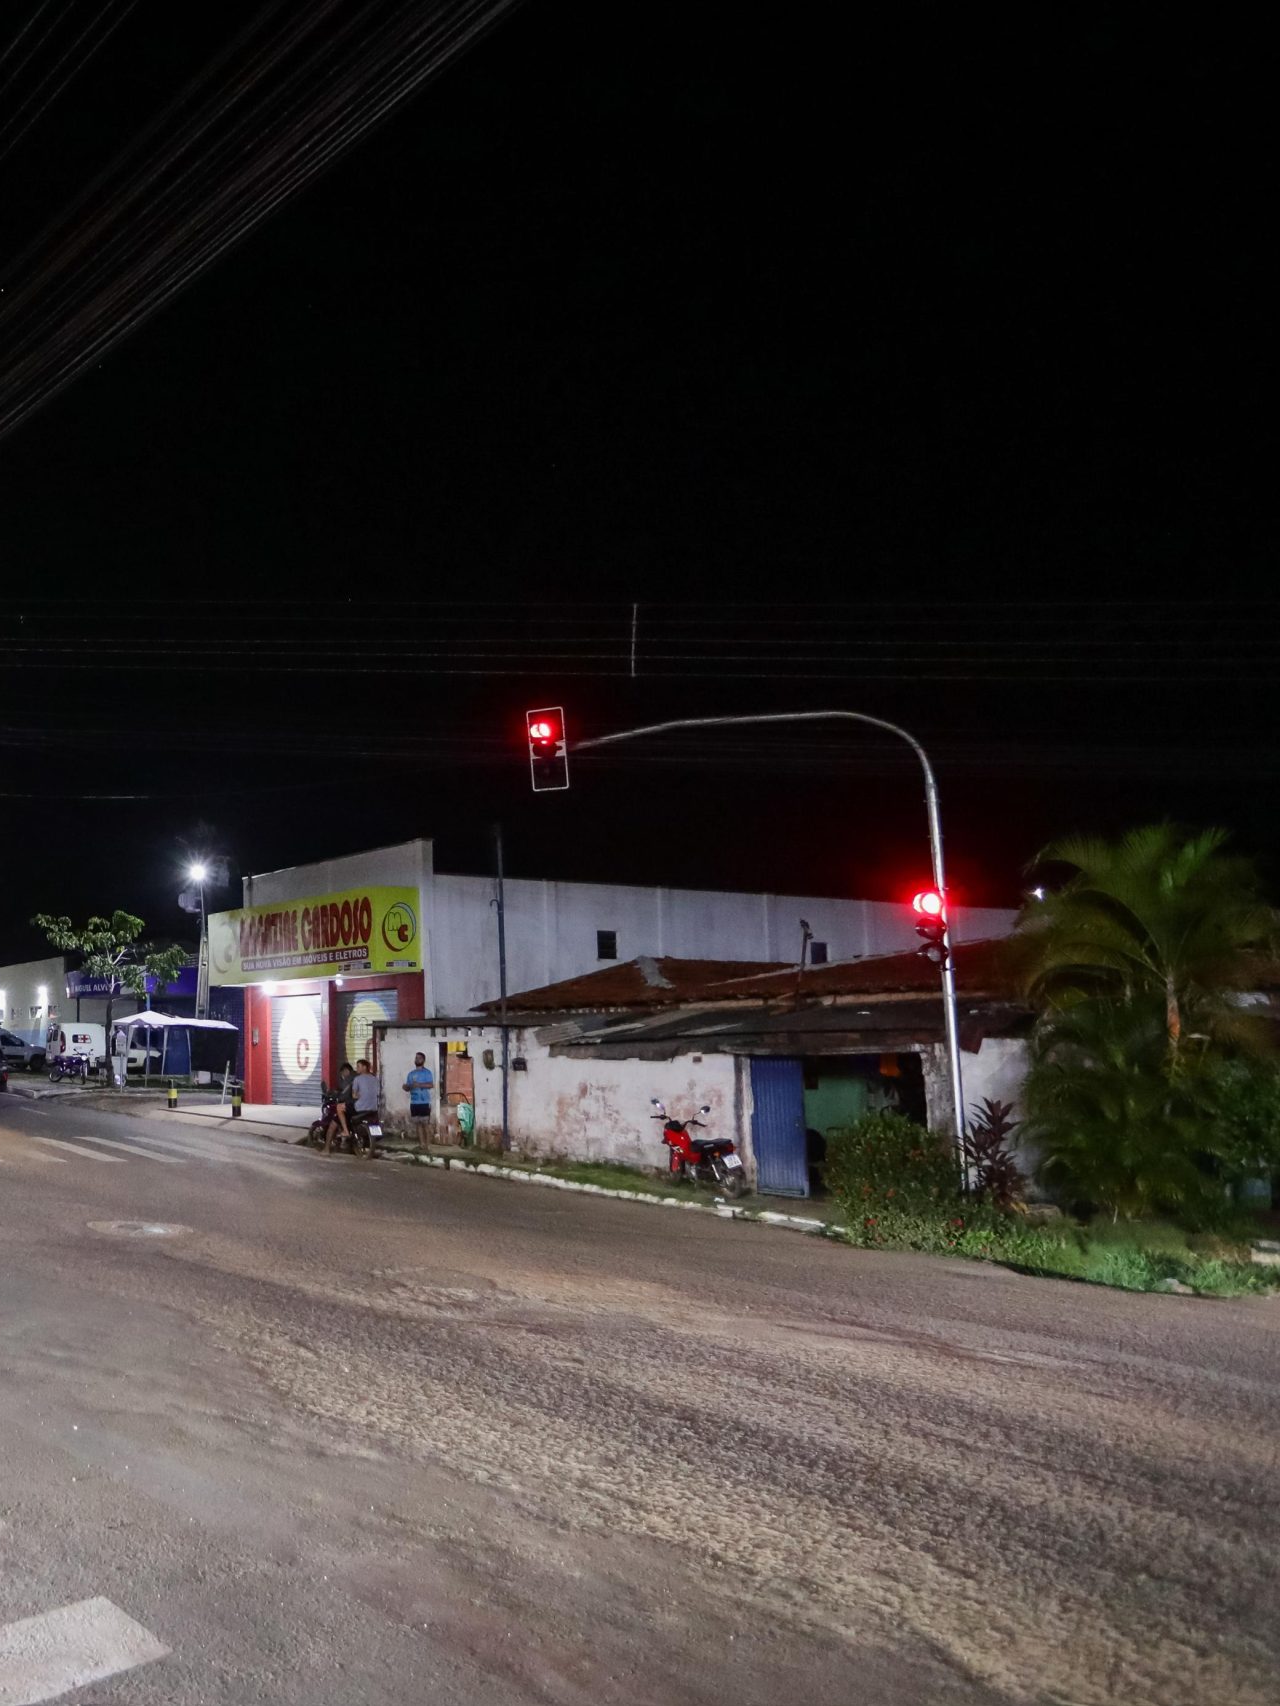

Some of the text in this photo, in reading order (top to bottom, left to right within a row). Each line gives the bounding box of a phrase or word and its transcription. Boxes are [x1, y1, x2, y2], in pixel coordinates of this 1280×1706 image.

[301, 896, 373, 951] CARDOSO
[272, 956, 291, 968] VISÃO
[292, 956, 302, 966] EM
[303, 952, 328, 964] MÓVEIS
[329, 952, 334, 961] E
[335, 947, 368, 960] ELETROS
